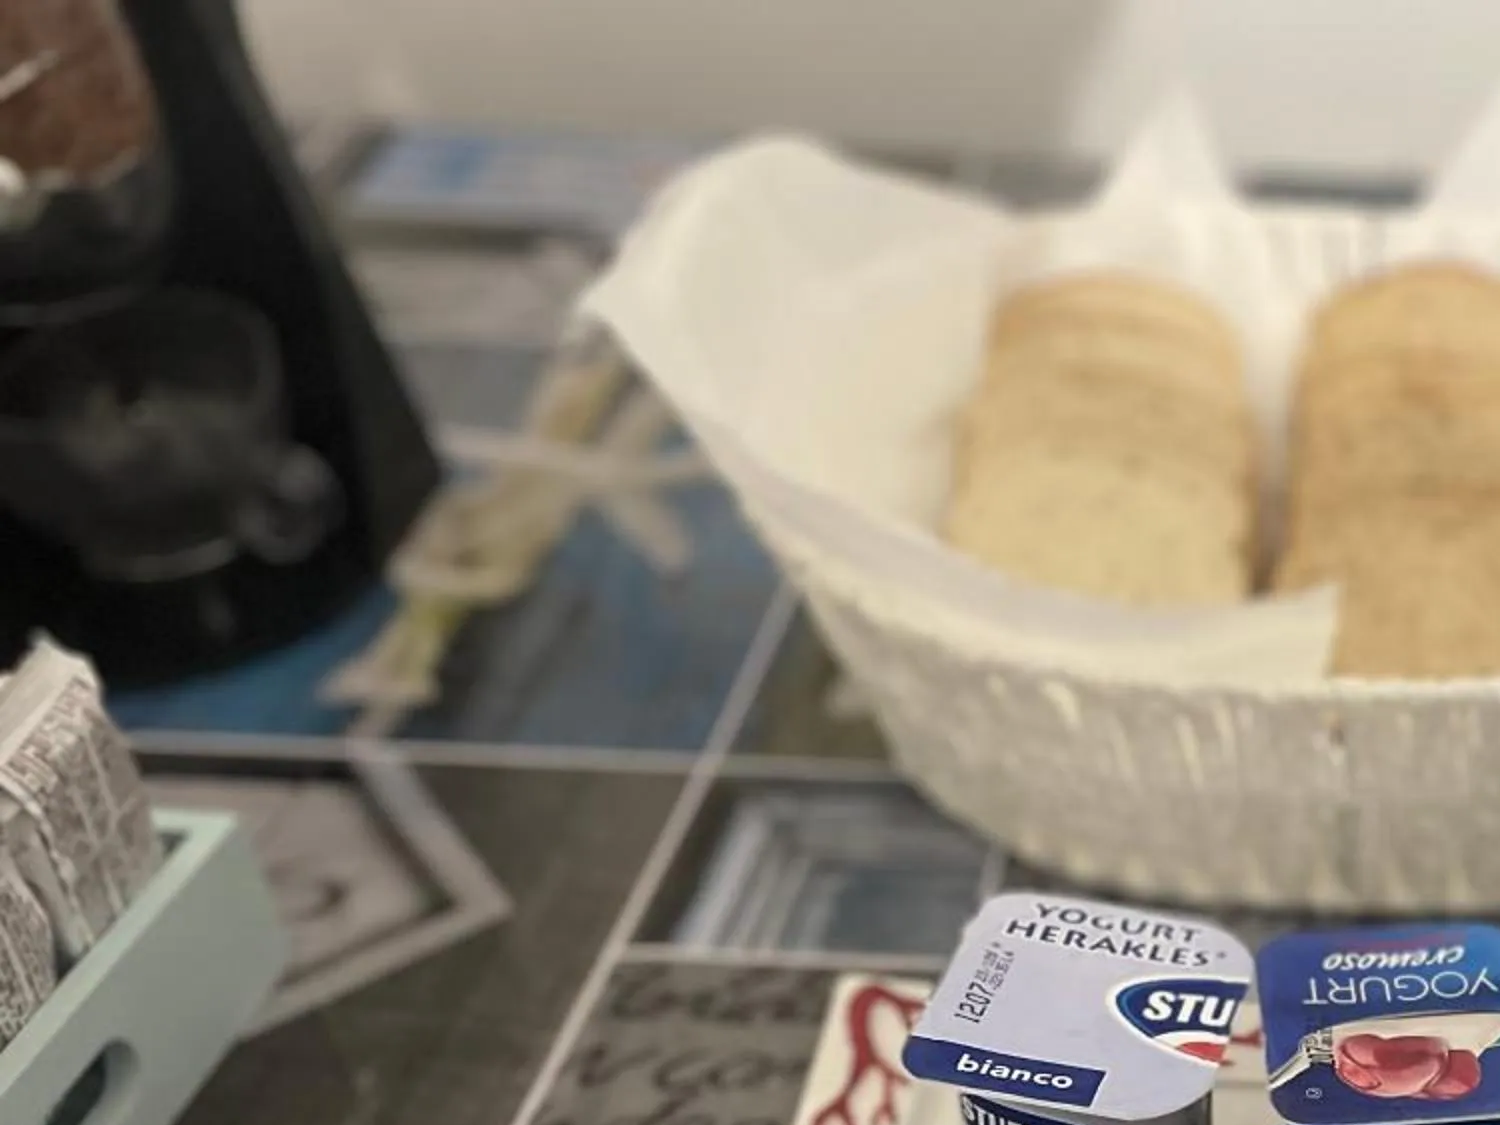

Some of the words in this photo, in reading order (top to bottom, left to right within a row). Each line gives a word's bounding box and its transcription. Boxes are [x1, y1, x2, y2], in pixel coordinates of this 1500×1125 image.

[1035, 902, 1203, 942] YOGURT
[1006, 921, 1209, 966] HERAKLES
[1323, 945, 1465, 971] cremoso
[1302, 967, 1499, 1005] YOGURT
[1142, 991, 1236, 1026] STU
[956, 1053, 1073, 1089] bianco
